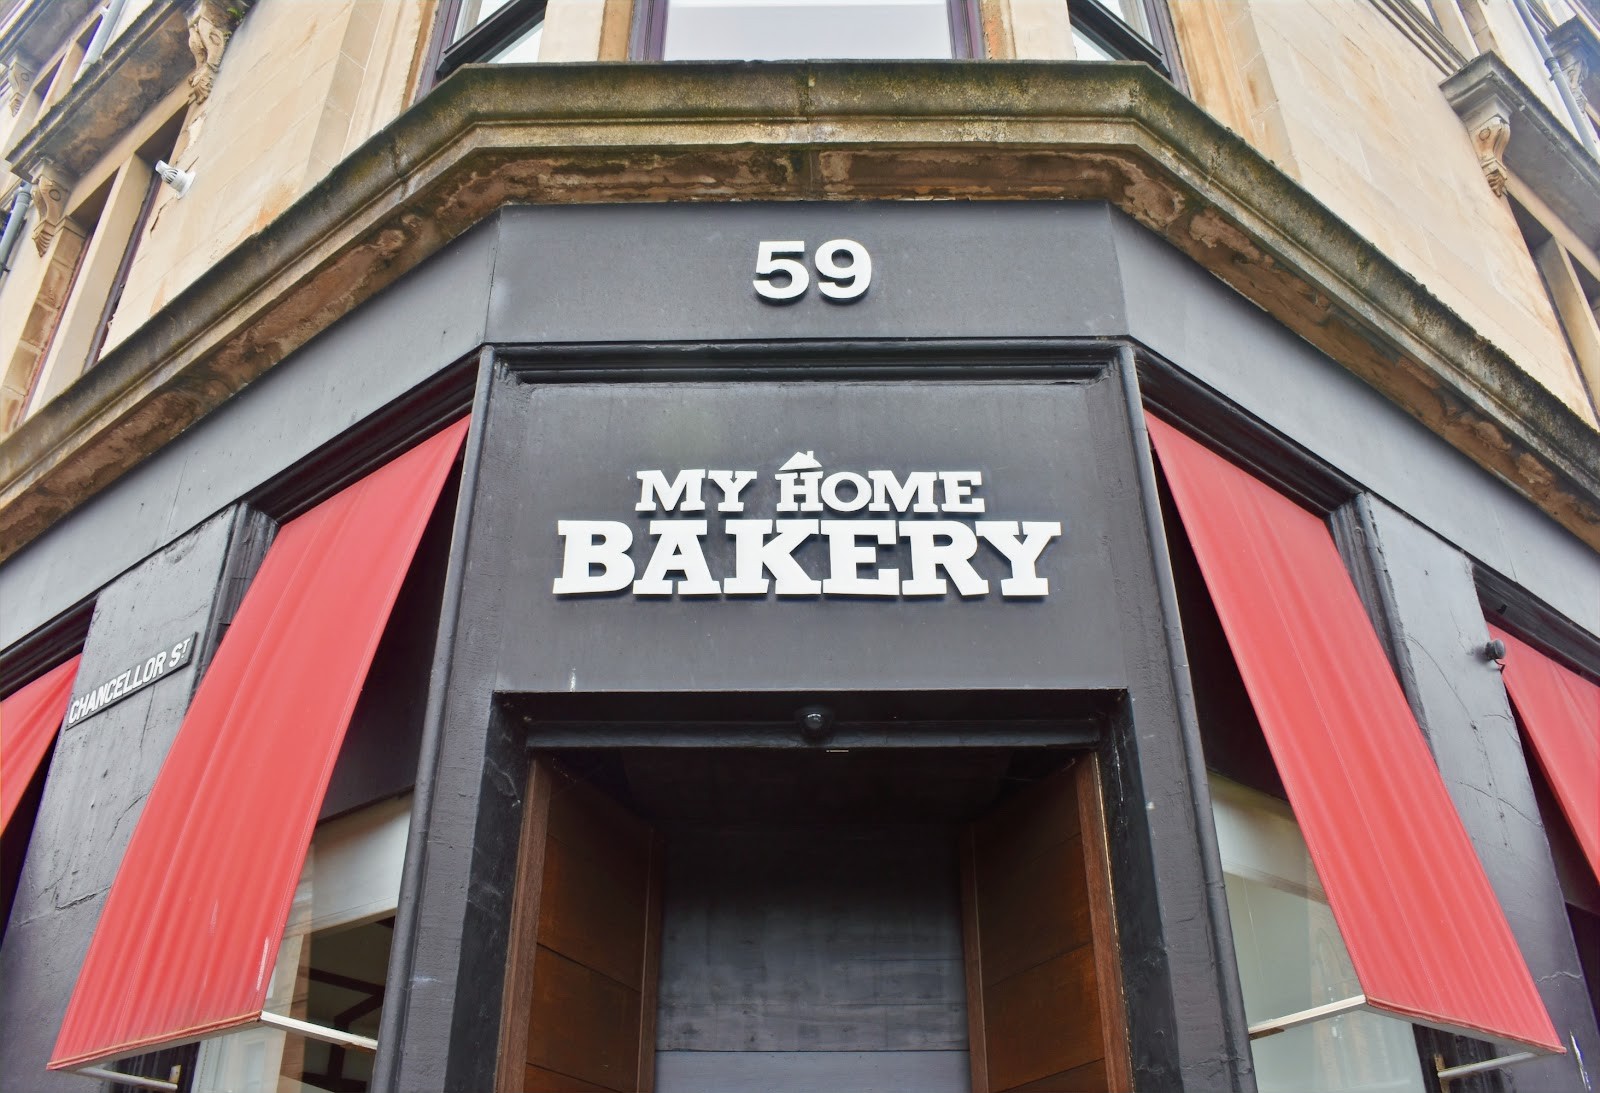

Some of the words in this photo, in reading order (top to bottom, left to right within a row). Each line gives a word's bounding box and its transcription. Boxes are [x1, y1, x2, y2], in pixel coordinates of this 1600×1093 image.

[752, 238, 873, 300] 59
[634, 468, 758, 513] MY
[774, 468, 987, 514] HOME
[552, 519, 1062, 597] BAKERY
[68, 651, 167, 724] CHANCELLOR
